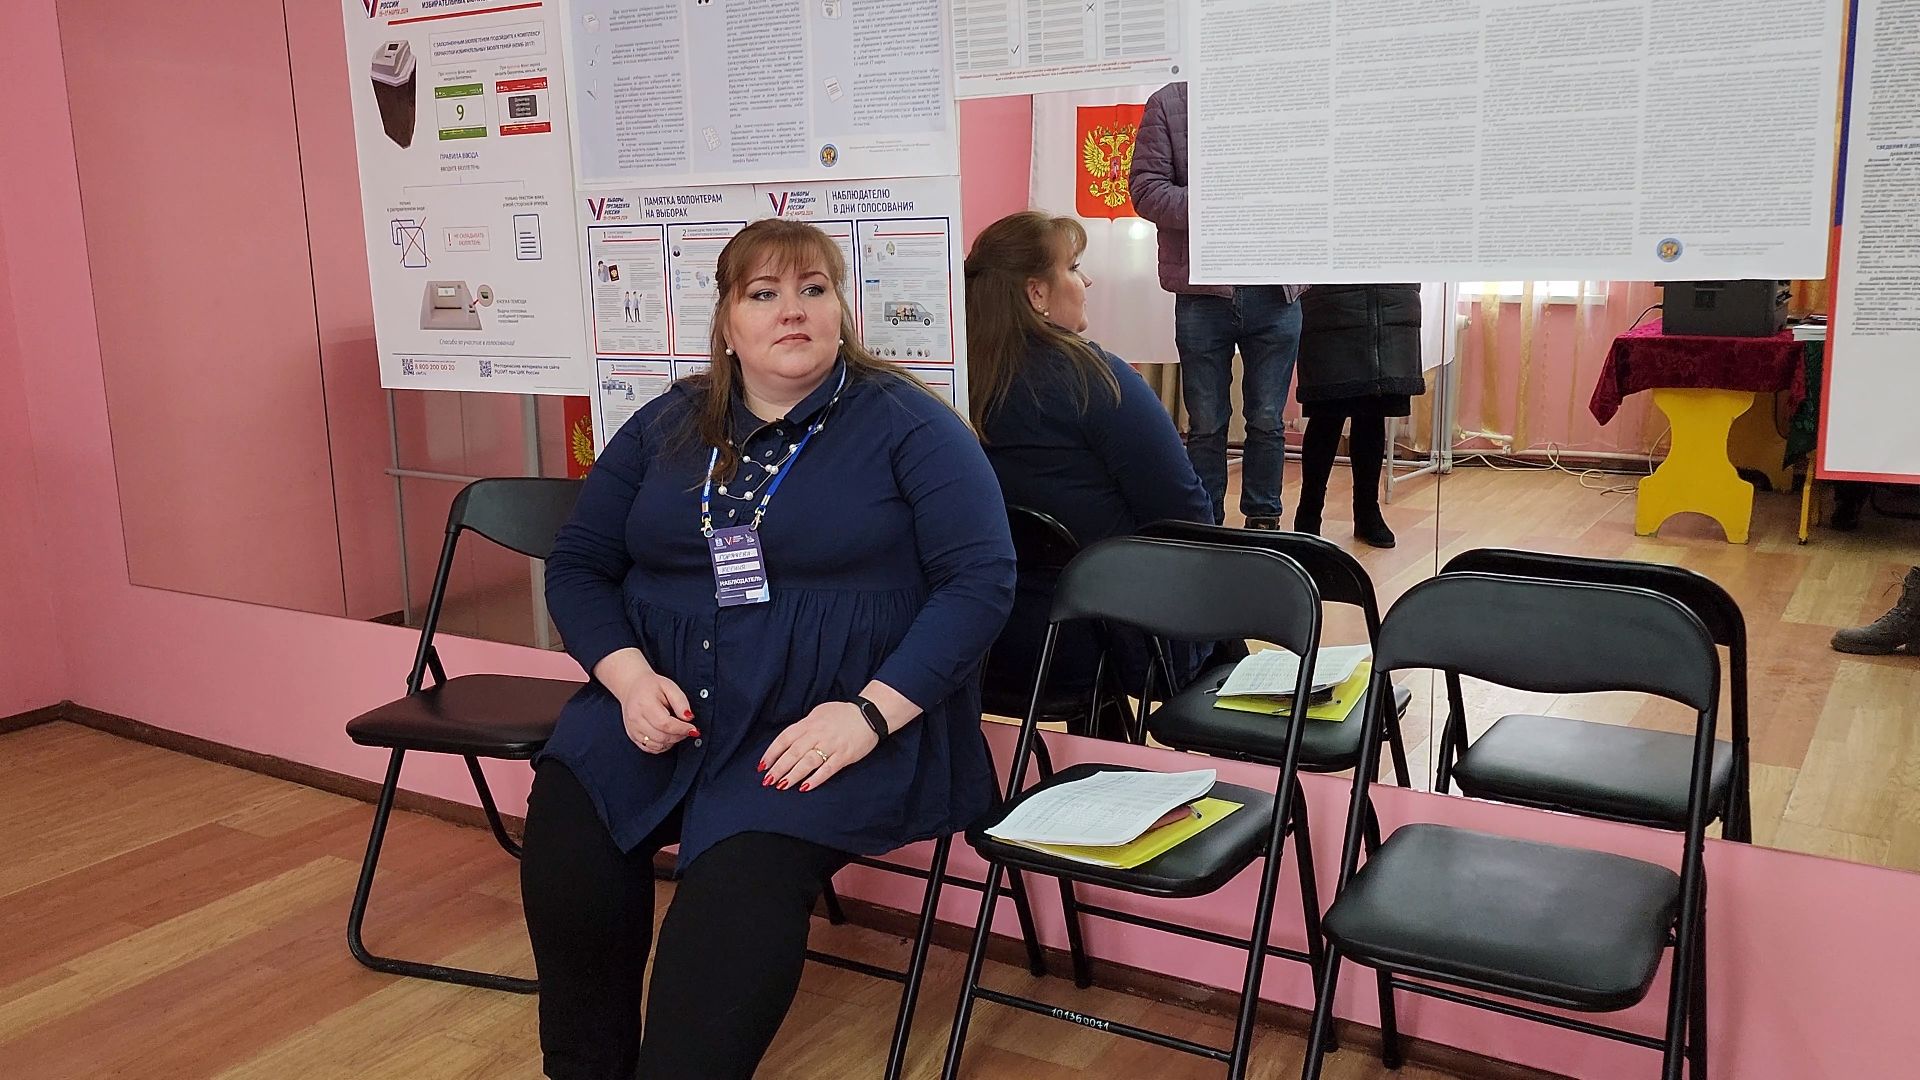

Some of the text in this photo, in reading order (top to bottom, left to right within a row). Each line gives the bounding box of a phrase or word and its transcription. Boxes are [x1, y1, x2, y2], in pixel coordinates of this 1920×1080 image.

[456, 104, 464, 121] 9
[644, 194, 723, 206] ПАМЯТКА ВОЛОНТЕРАМ
[832, 189, 890, 201] НАБЛЮДАТЕЛЮ
[834, 201, 914, 214] В ДНИ ГОЛОСОВАНИЯ
[646, 208, 688, 218] НА ВЫБОРАХ
[682, 229, 687, 237] 2
[874, 224, 879, 233] 2
[603, 231, 606, 239] 1
[611, 364, 616, 372] 3
[690, 366, 694, 374] 4
[720, 577, 762, 587] НАБЛЮДАТЕЛЬ
[1052, 1008, 1109, 1030] 101360071
